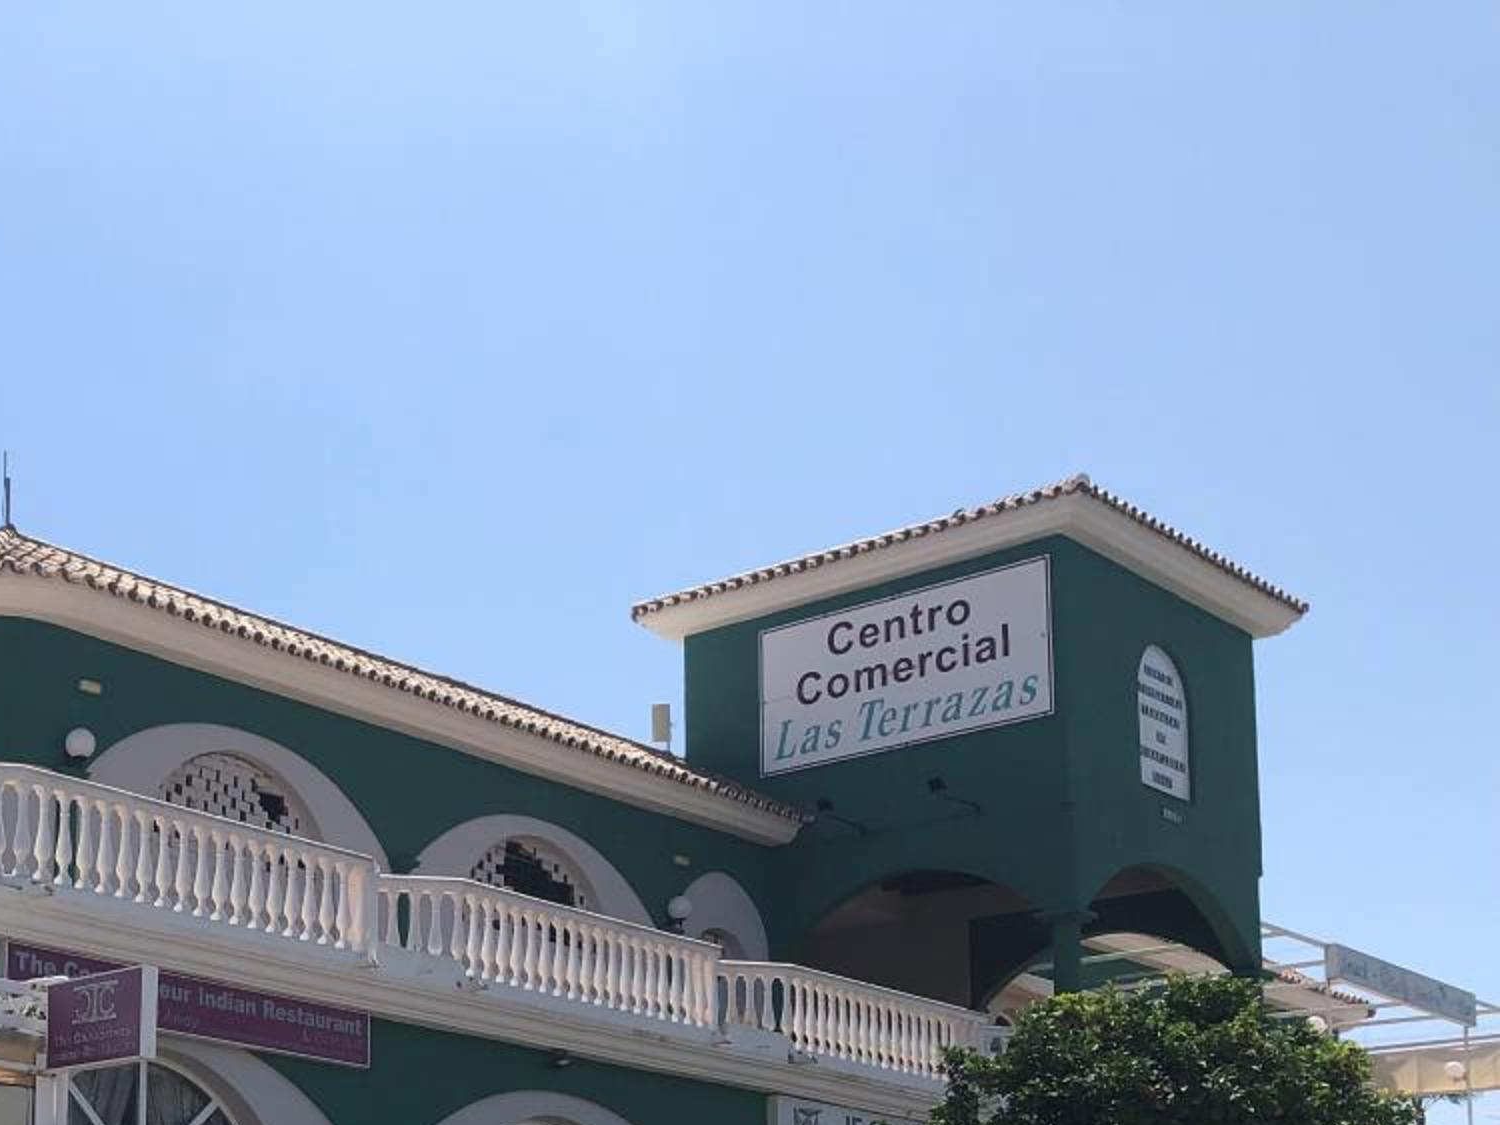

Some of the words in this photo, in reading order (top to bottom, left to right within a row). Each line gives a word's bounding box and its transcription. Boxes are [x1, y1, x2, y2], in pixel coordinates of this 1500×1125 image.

[796, 624, 1011, 706] Comercial
[827, 598, 971, 655] Centro
[773, 717, 842, 762] Las
[857, 673, 1039, 743] Terrazas
[15, 951, 57, 976] The
[199, 986, 257, 1017] Indian
[263, 999, 362, 1036] Restaurant
